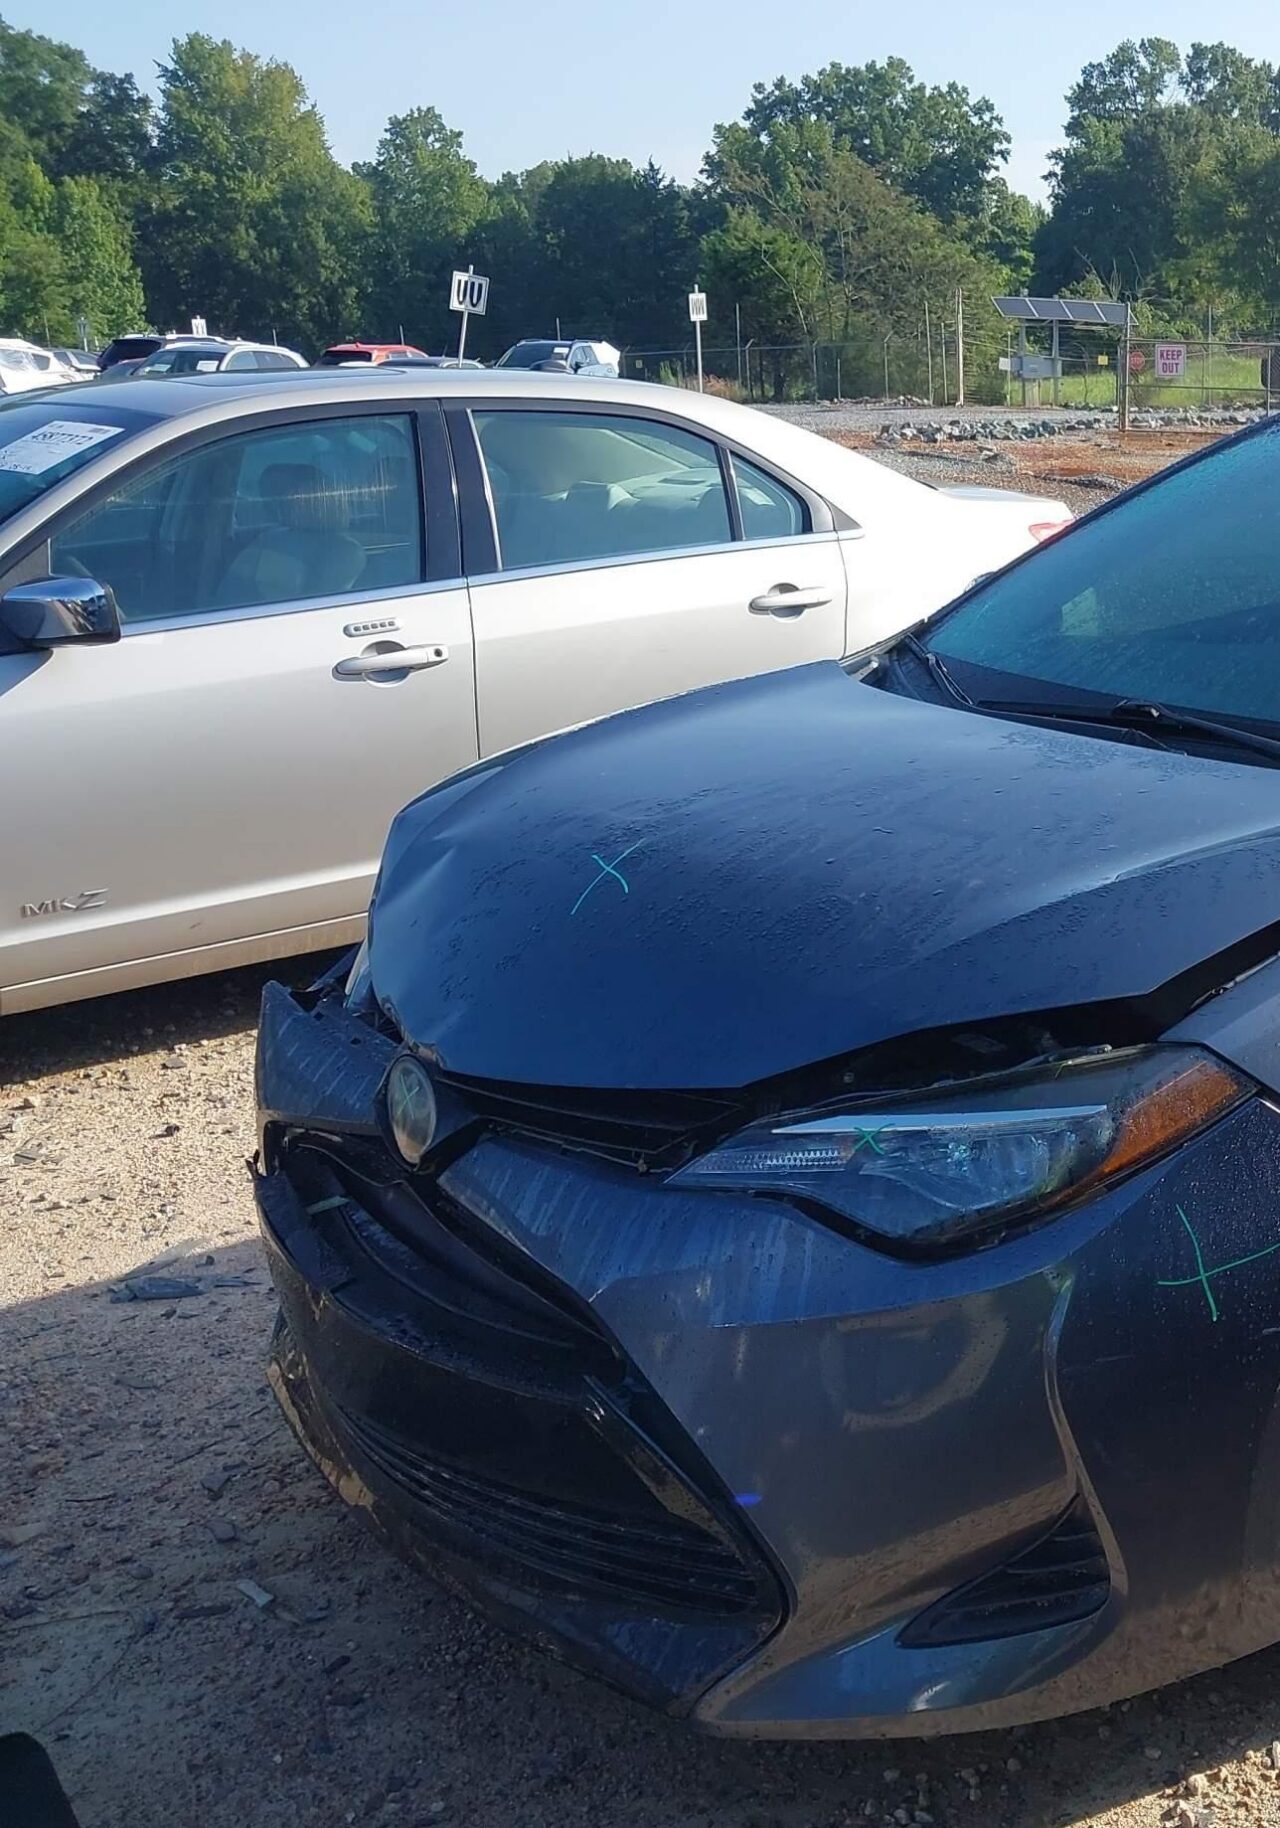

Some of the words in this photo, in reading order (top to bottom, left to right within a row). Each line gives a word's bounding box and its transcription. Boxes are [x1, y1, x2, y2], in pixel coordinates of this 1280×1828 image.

[456, 279, 483, 308] UU
[1160, 350, 1183, 361] KEEP
[1162, 363, 1180, 373] OUT
[21, 888, 108, 918] MKZ
